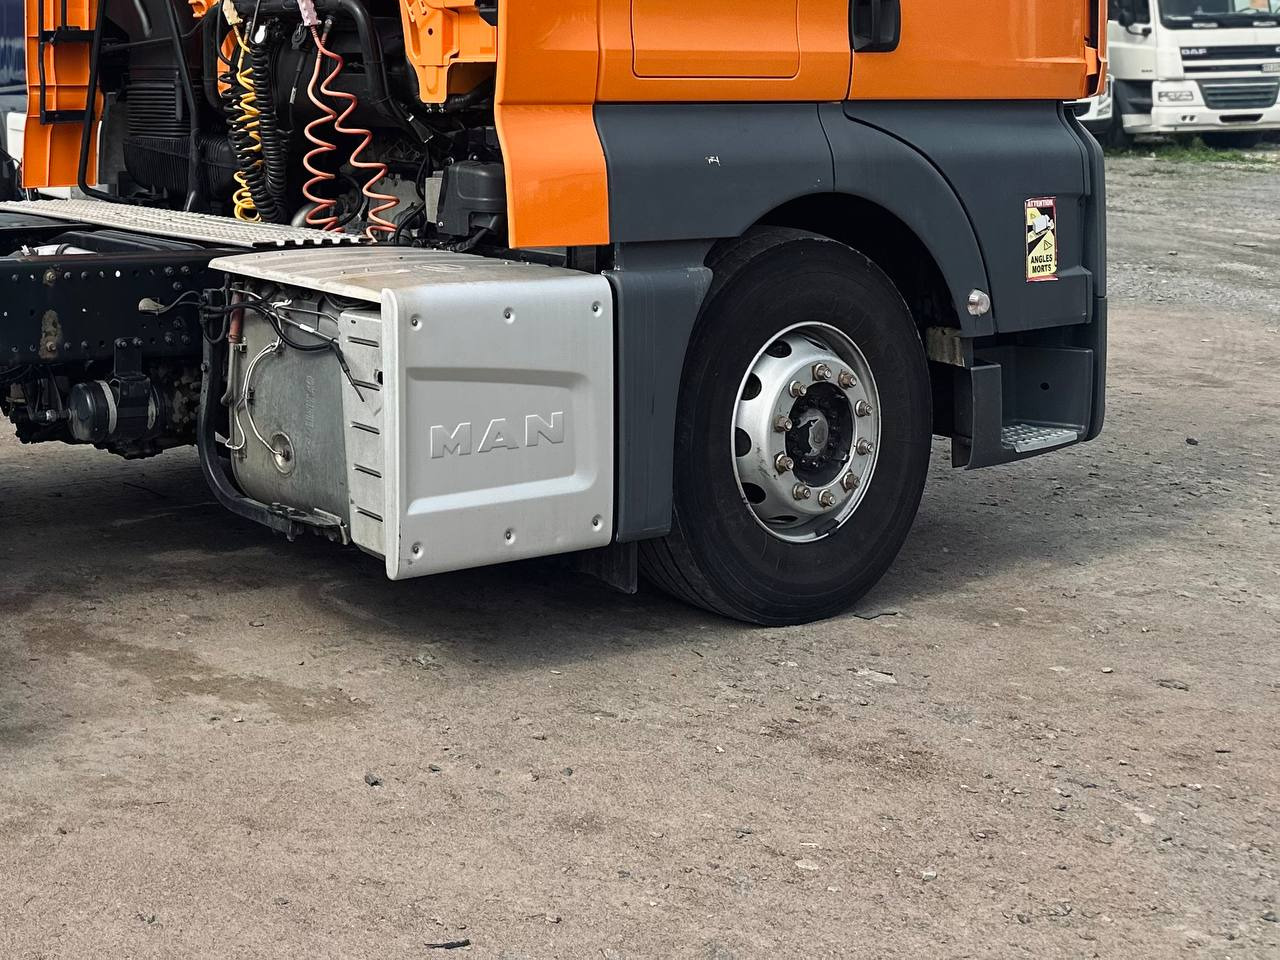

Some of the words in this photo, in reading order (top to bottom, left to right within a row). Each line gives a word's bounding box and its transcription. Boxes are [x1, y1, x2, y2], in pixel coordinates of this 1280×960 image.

[1181, 48, 1207, 56] DAF
[1030, 254, 1053, 264] ANGLES
[1031, 264, 1051, 273] MORTS
[430, 411, 565, 459] MAN
